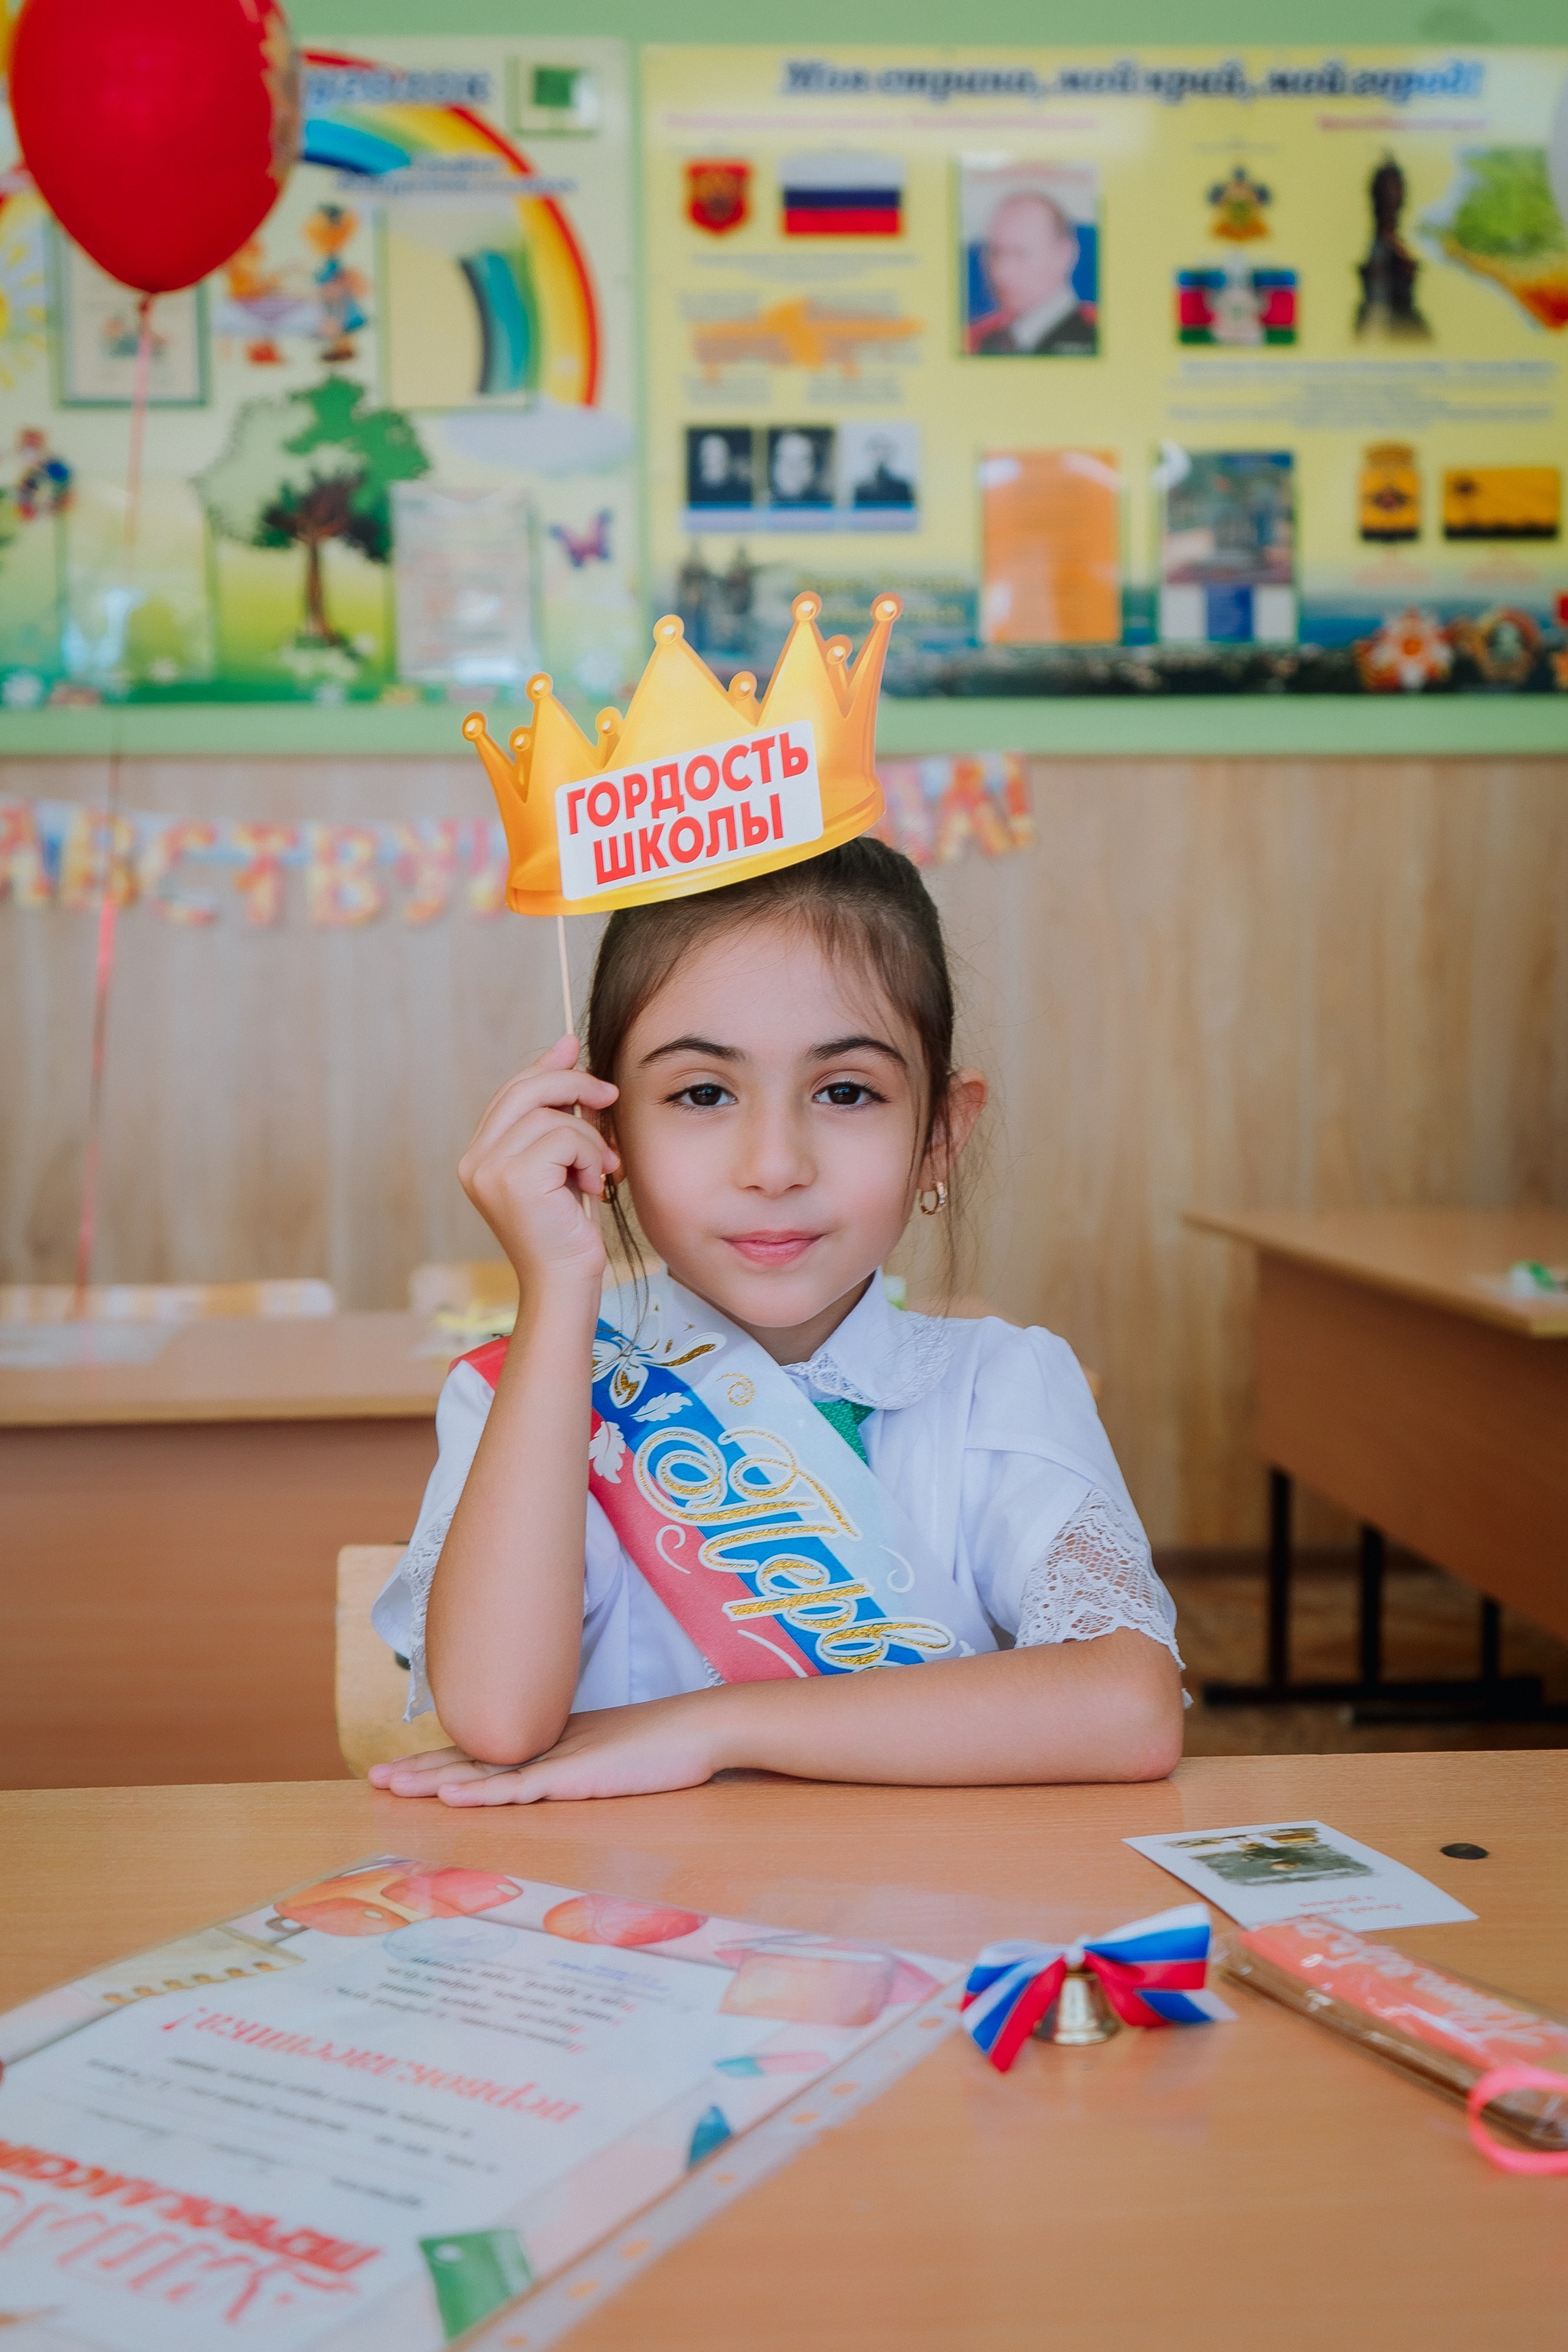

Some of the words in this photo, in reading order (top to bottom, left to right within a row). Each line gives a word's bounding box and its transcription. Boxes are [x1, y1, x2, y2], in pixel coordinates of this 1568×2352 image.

[566, 731, 809, 836] ГОРДОСТЬ
[592, 793, 785, 886] ШКОЛЫ
[631, 1426, 957, 1674] Перв
